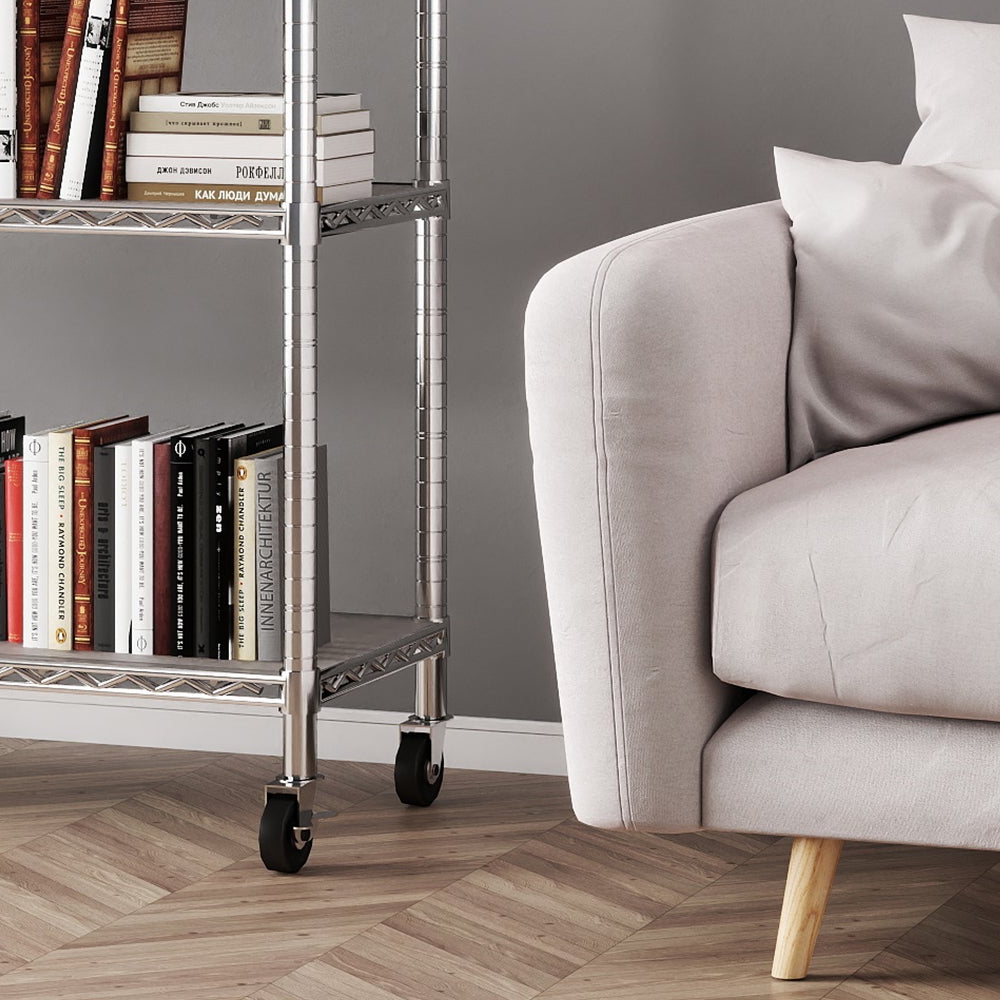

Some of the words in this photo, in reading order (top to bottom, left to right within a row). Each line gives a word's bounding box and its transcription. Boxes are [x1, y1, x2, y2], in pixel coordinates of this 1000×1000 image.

[157, 166, 177, 174] ДЖОН
[195, 190, 216, 200] КАК
[218, 190, 250, 201] ЛЮДИ
[77, 499, 87, 550] UNEXPECTED
[77, 551, 87, 585] JOURNEY
[257, 473, 274, 630] INNENARCHITEKTUR
